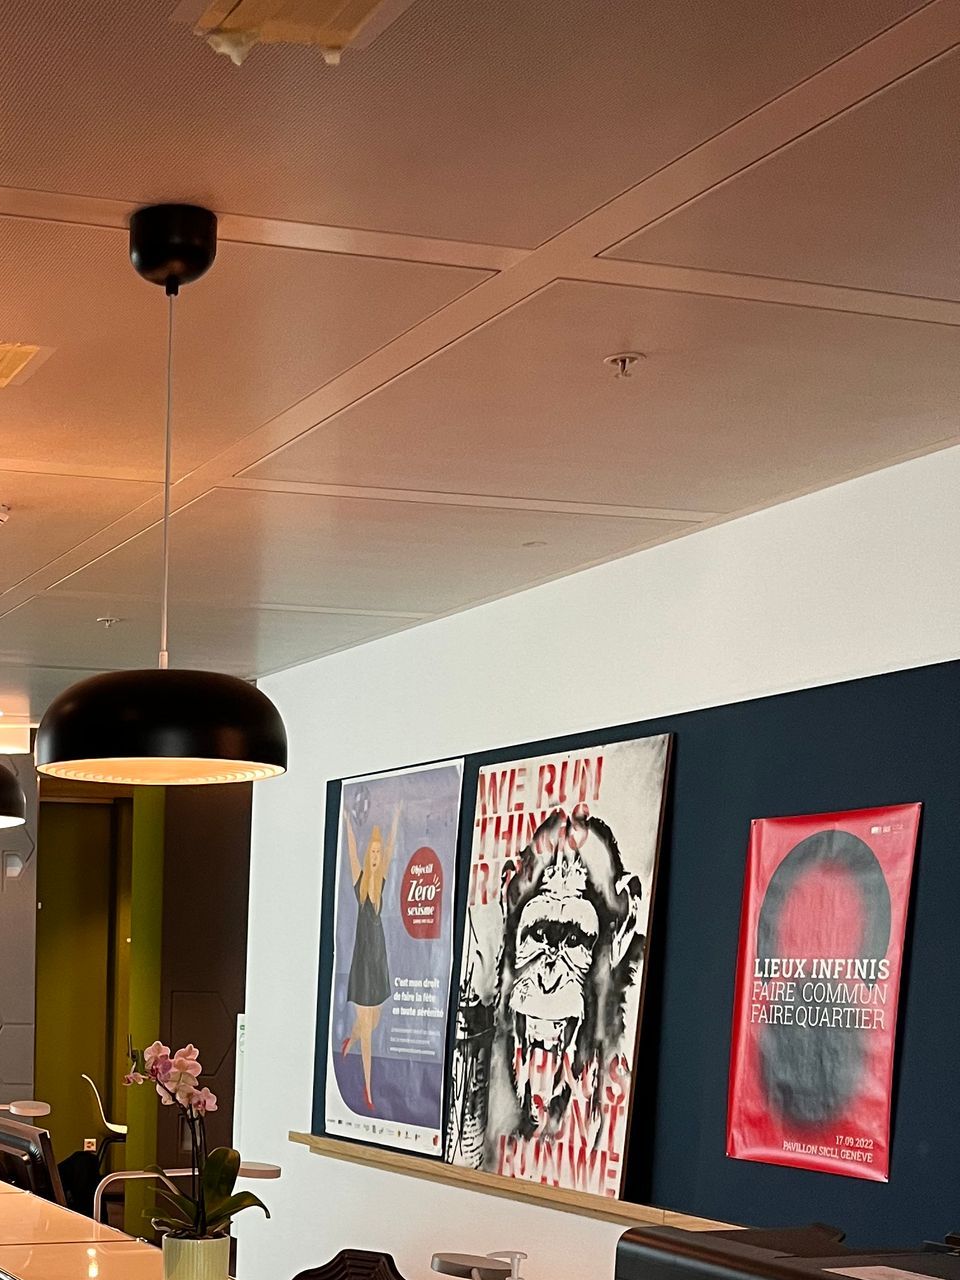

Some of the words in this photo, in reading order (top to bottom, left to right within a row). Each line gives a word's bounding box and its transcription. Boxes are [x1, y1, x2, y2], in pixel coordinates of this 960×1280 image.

[479, 767, 527, 815] WE
[538, 756, 603, 809] RUN
[407, 878, 436, 902] Zéro
[407, 903, 435, 916] sexisme
[753, 958, 807, 978] LIEUX
[811, 958, 890, 980] INFINIS
[751, 981, 796, 1001] FAIRE
[802, 983, 889, 1005] COMMUN
[750, 1004, 794, 1025] FAIRE
[795, 1006, 886, 1029] QUARTIER
[782, 1140, 818, 1155] PAVILLON
